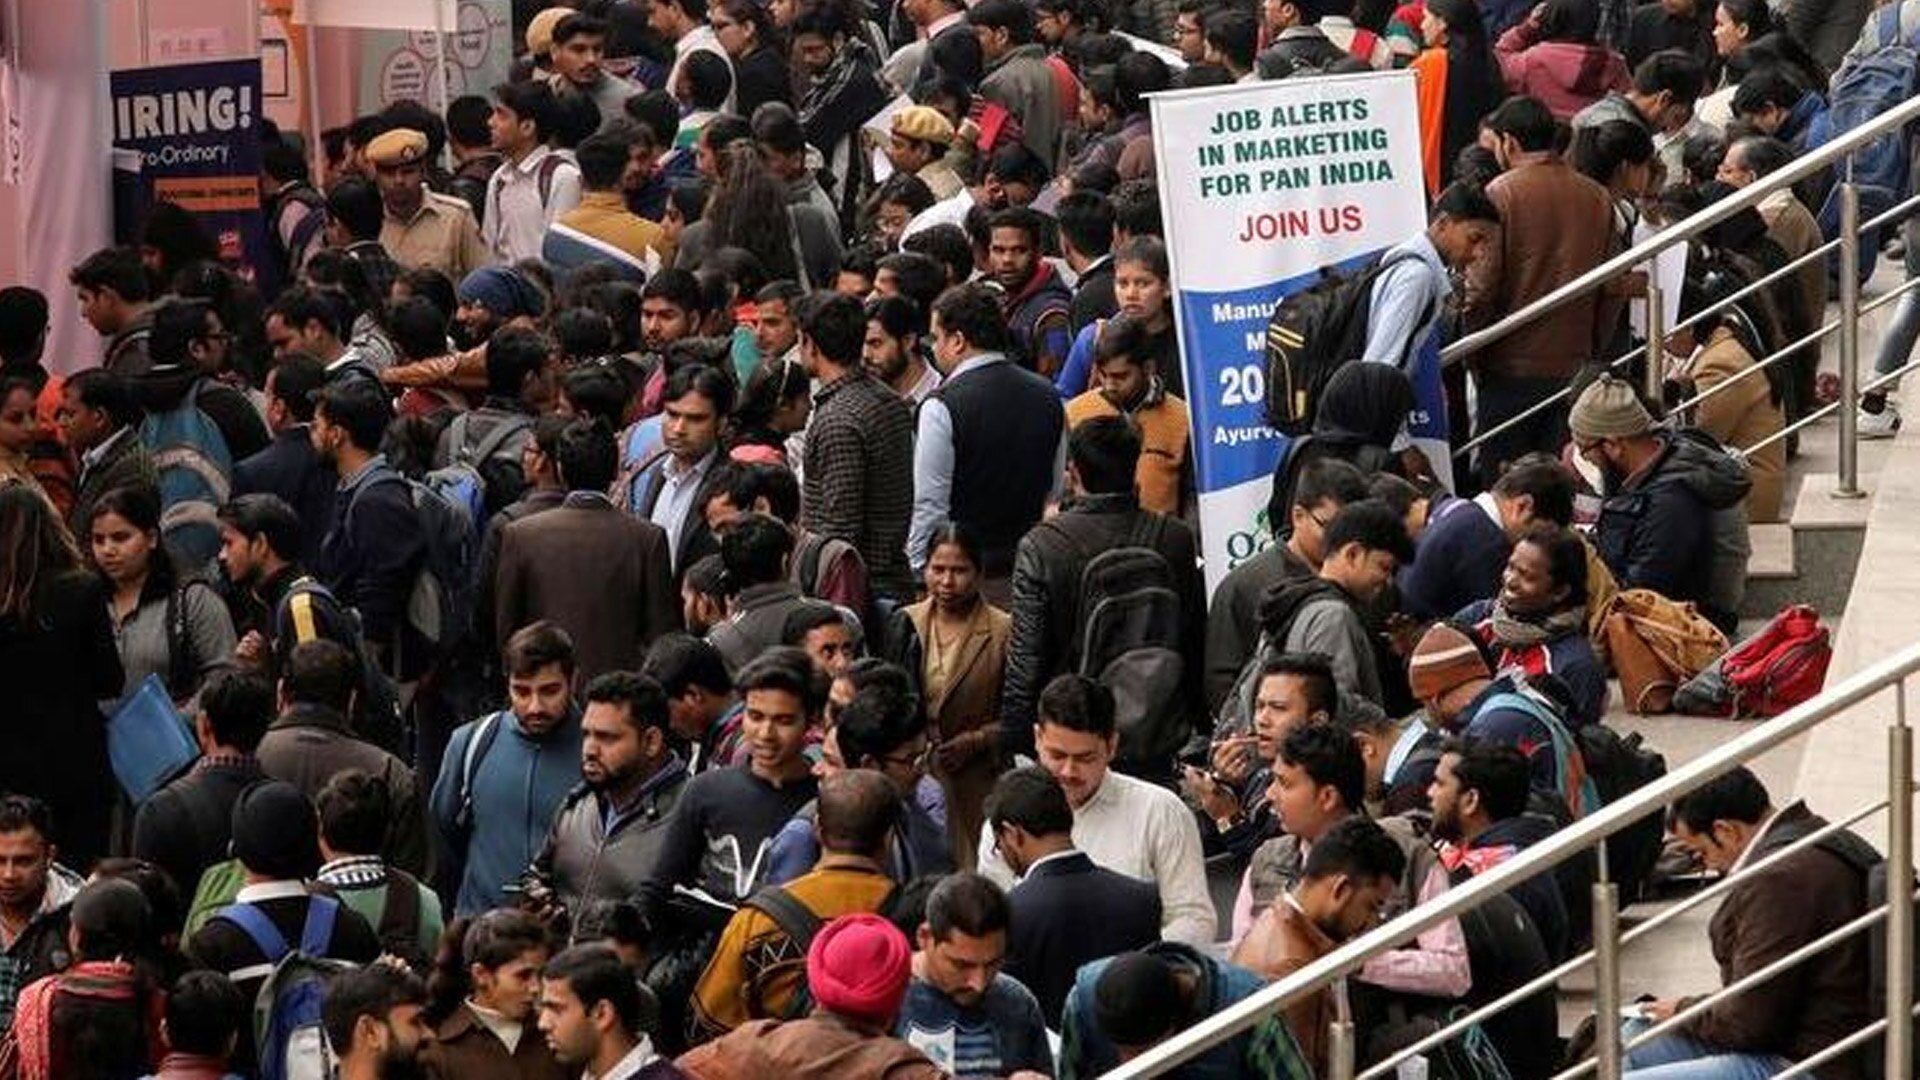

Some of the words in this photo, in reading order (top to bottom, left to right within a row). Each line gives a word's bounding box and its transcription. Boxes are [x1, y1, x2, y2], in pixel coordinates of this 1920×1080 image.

[1210, 109, 1261, 134] JOB
[1271, 98, 1368, 126] ALERTS
[1198, 145, 1225, 167] IN
[1235, 128, 1388, 162] MARKETING
[1200, 171, 1251, 198] FOR
[1261, 167, 1310, 191] PAN
[1320, 160, 1393, 186] INDIA
[1239, 210, 1308, 243] JOIN
[1320, 205, 1363, 234] US
[1212, 297, 1284, 323] Manu
[1219, 366, 1265, 407] 20
